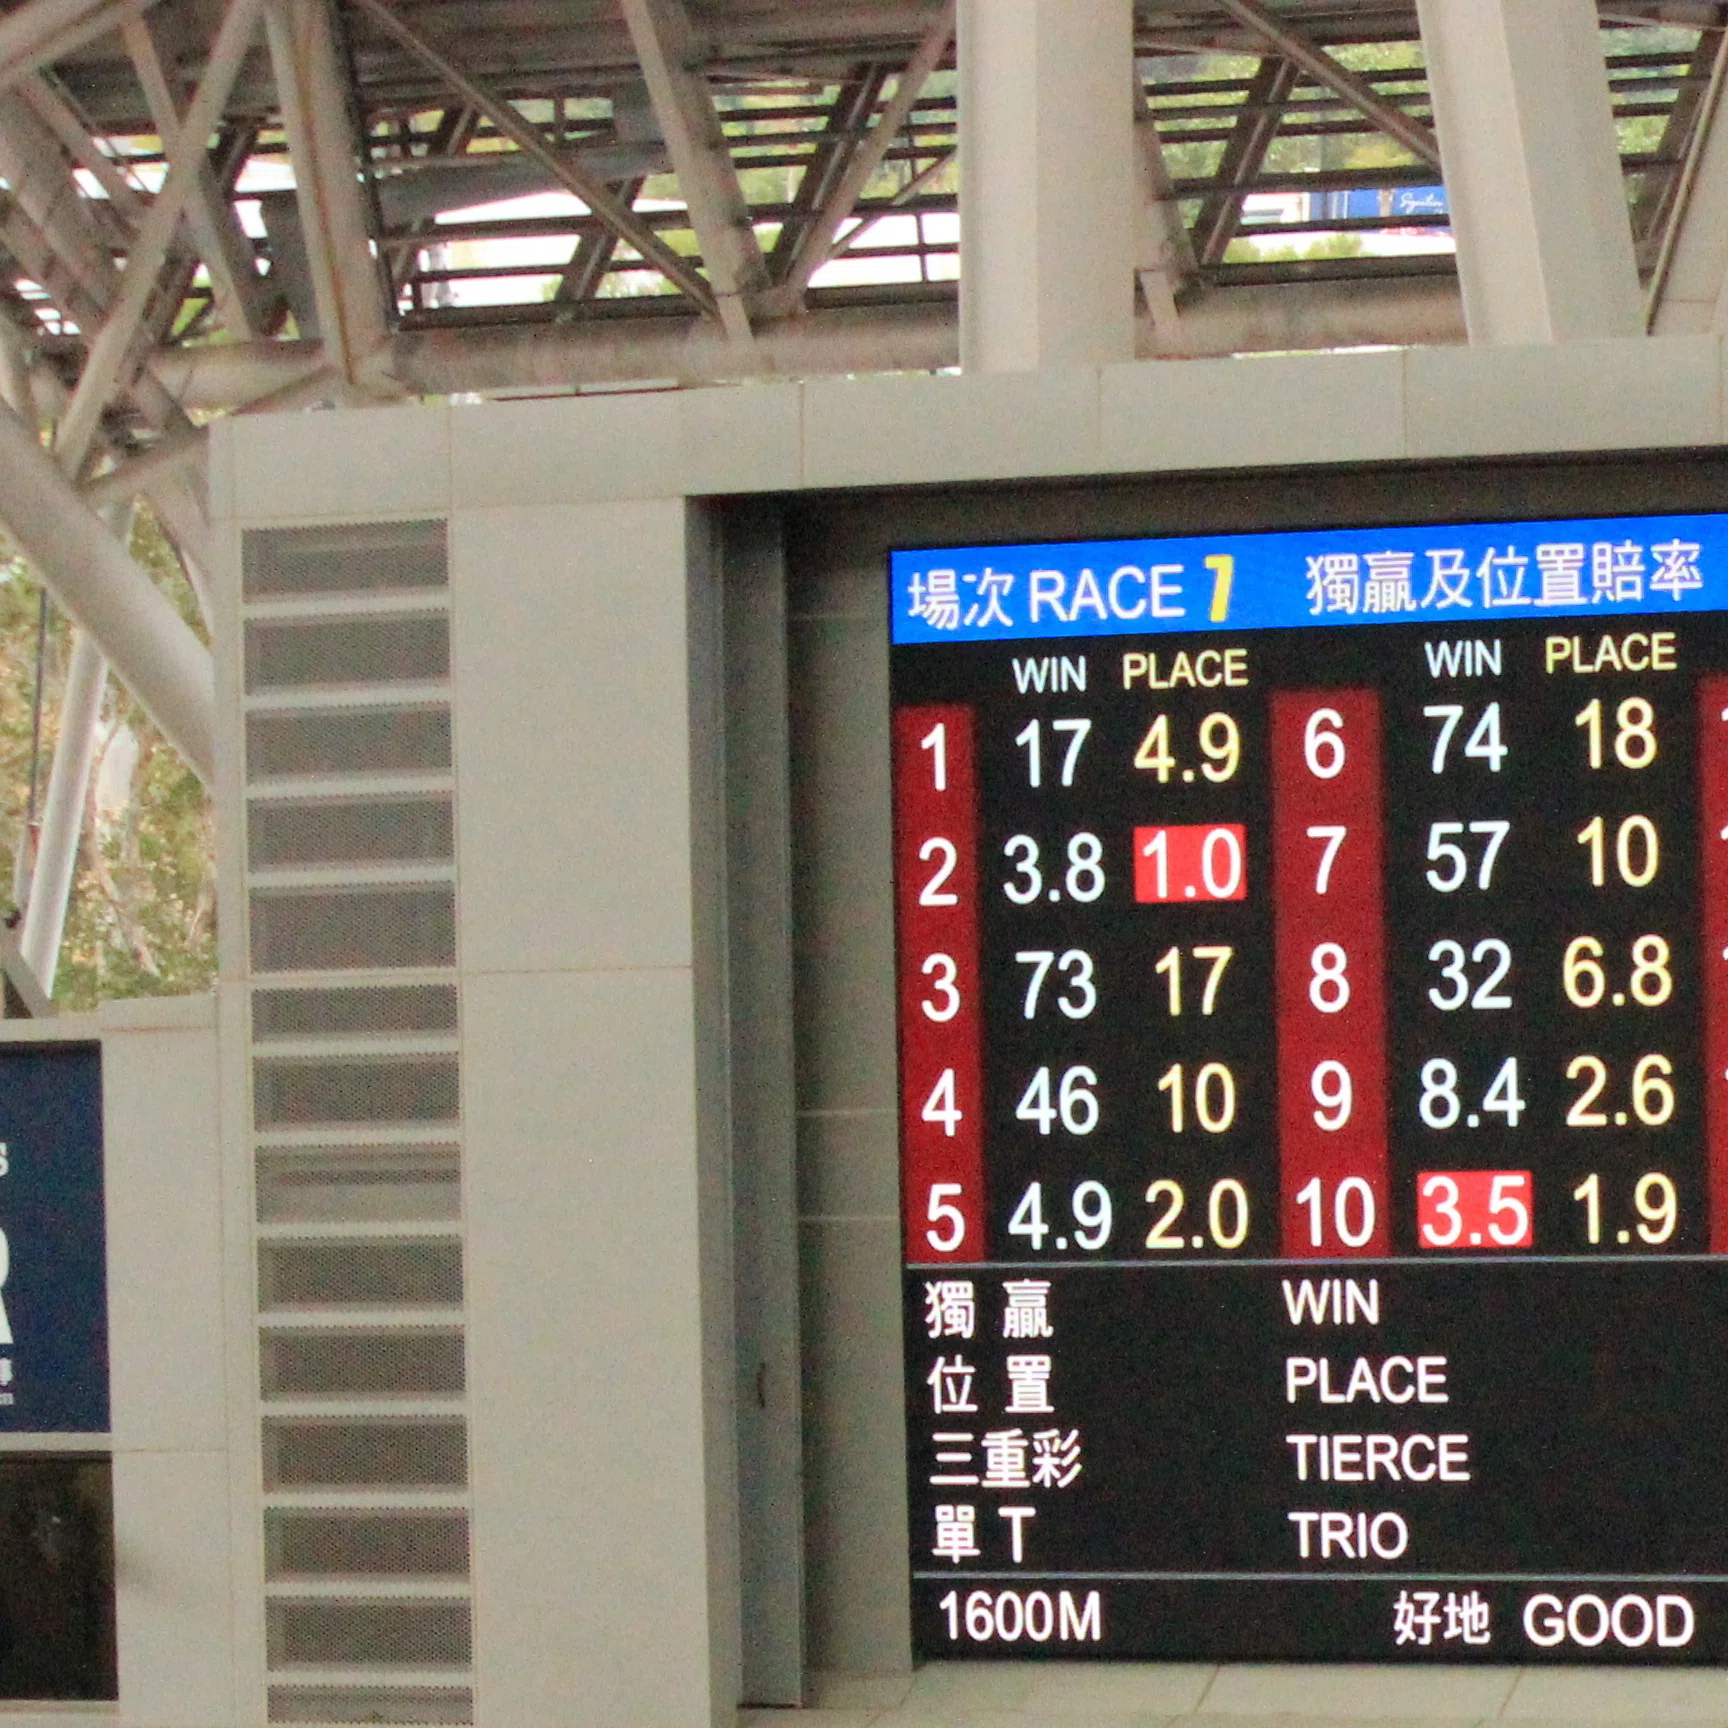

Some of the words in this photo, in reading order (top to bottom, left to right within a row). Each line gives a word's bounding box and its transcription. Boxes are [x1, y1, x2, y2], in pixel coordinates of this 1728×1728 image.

[907, 566, 1015, 632] 場次
[1029, 563, 1187, 624] RACE
[1204, 554, 1235, 624] 7
[1305, 538, 1704, 617] 獨贏及位置賠率
[1012, 655, 1086, 694] WIN
[1123, 648, 1249, 690] PLACE
[1424, 639, 1502, 678] WIN
[1546, 632, 1677, 674] PLACE
[921, 723, 946, 791] 1
[1015, 718, 1092, 788] 17
[1134, 712, 1240, 783] 4.9
[1304, 708, 1345, 779] 6
[1423, 702, 1508, 774] 74
[1575, 697, 1657, 769] 18
[919, 837, 958, 906] 2
[1003, 832, 1106, 905] 3.8
[1143, 828, 1242, 899] 1.0
[1306, 825, 1347, 894] 7
[1426, 820, 1510, 892] 57
[1577, 815, 1659, 887] 10
[922, 953, 960, 1022] 3
[1015, 949, 1097, 1019] 73
[1155, 946, 1233, 1016] 17
[1309, 942, 1350, 1013] 8
[1428, 938, 1512, 1011] 32
[1563, 934, 1672, 1008] 6.8
[922, 1068, 963, 1137] 4
[1015, 1065, 1099, 1135] 46
[1158, 1063, 1235, 1133] 10
[1311, 1060, 1352, 1131] 9
[1419, 1057, 1526, 1129] 8.4
[1566, 1054, 1675, 1127] 2.6
[926, 1183, 965, 1252] 5
[1008, 1180, 1112, 1250] 4.9
[1145, 1178, 1248, 1249] 2.0
[1296, 1176, 1375, 1247] 10
[1422, 1174, 1529, 1246] 3.5
[1574, 1173, 1677, 1244] 1.9
[1282, 1279, 1379, 1325] WIN
[1286, 1355, 1449, 1404] PLACE
[929, 1428, 1082, 1488] 三重彩
[1285, 1434, 1471, 1481] TIERCE
[1287, 1512, 1408, 1559] TRIO
[939, 1590, 1101, 1642] 1600M
[1393, 1590, 1491, 1645] 好地
[1523, 1593, 1695, 1647] GOOD
